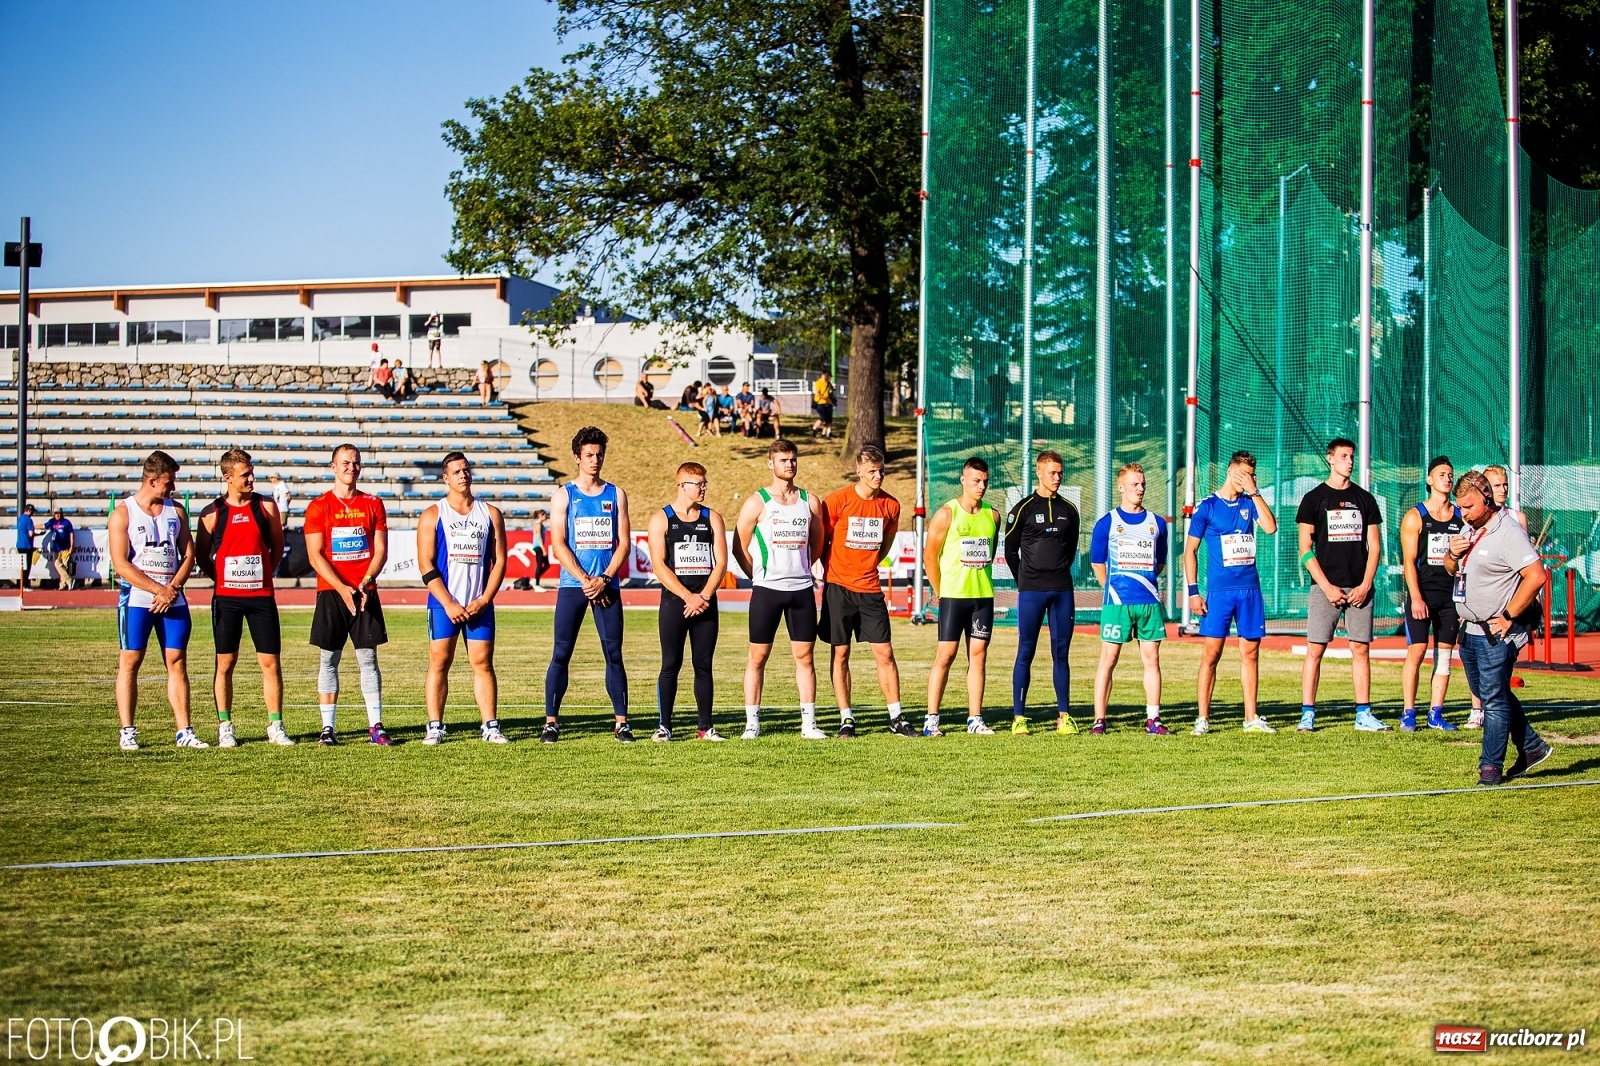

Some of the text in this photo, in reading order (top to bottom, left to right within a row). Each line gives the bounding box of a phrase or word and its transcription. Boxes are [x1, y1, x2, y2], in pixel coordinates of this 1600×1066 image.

[1351, 511, 1357, 519] 6
[594, 517, 611, 526] 660
[792, 517, 807, 526] 629
[868, 518, 880, 527] 80
[576, 530, 611, 538] KOWALSKI
[852, 530, 879, 538] WEGNER
[1240, 535, 1254, 543] 128
[337, 540, 364, 549] TREJGO
[695, 543, 709, 552] 171
[1136, 540, 1153, 548] 434
[245, 556, 261, 565] 323
[679, 555, 708, 563] WISEŁKA
[392, 558, 415, 572] JEST
[231, 569, 257, 577] KUSIAK
[1103, 623, 1122, 640] 66
